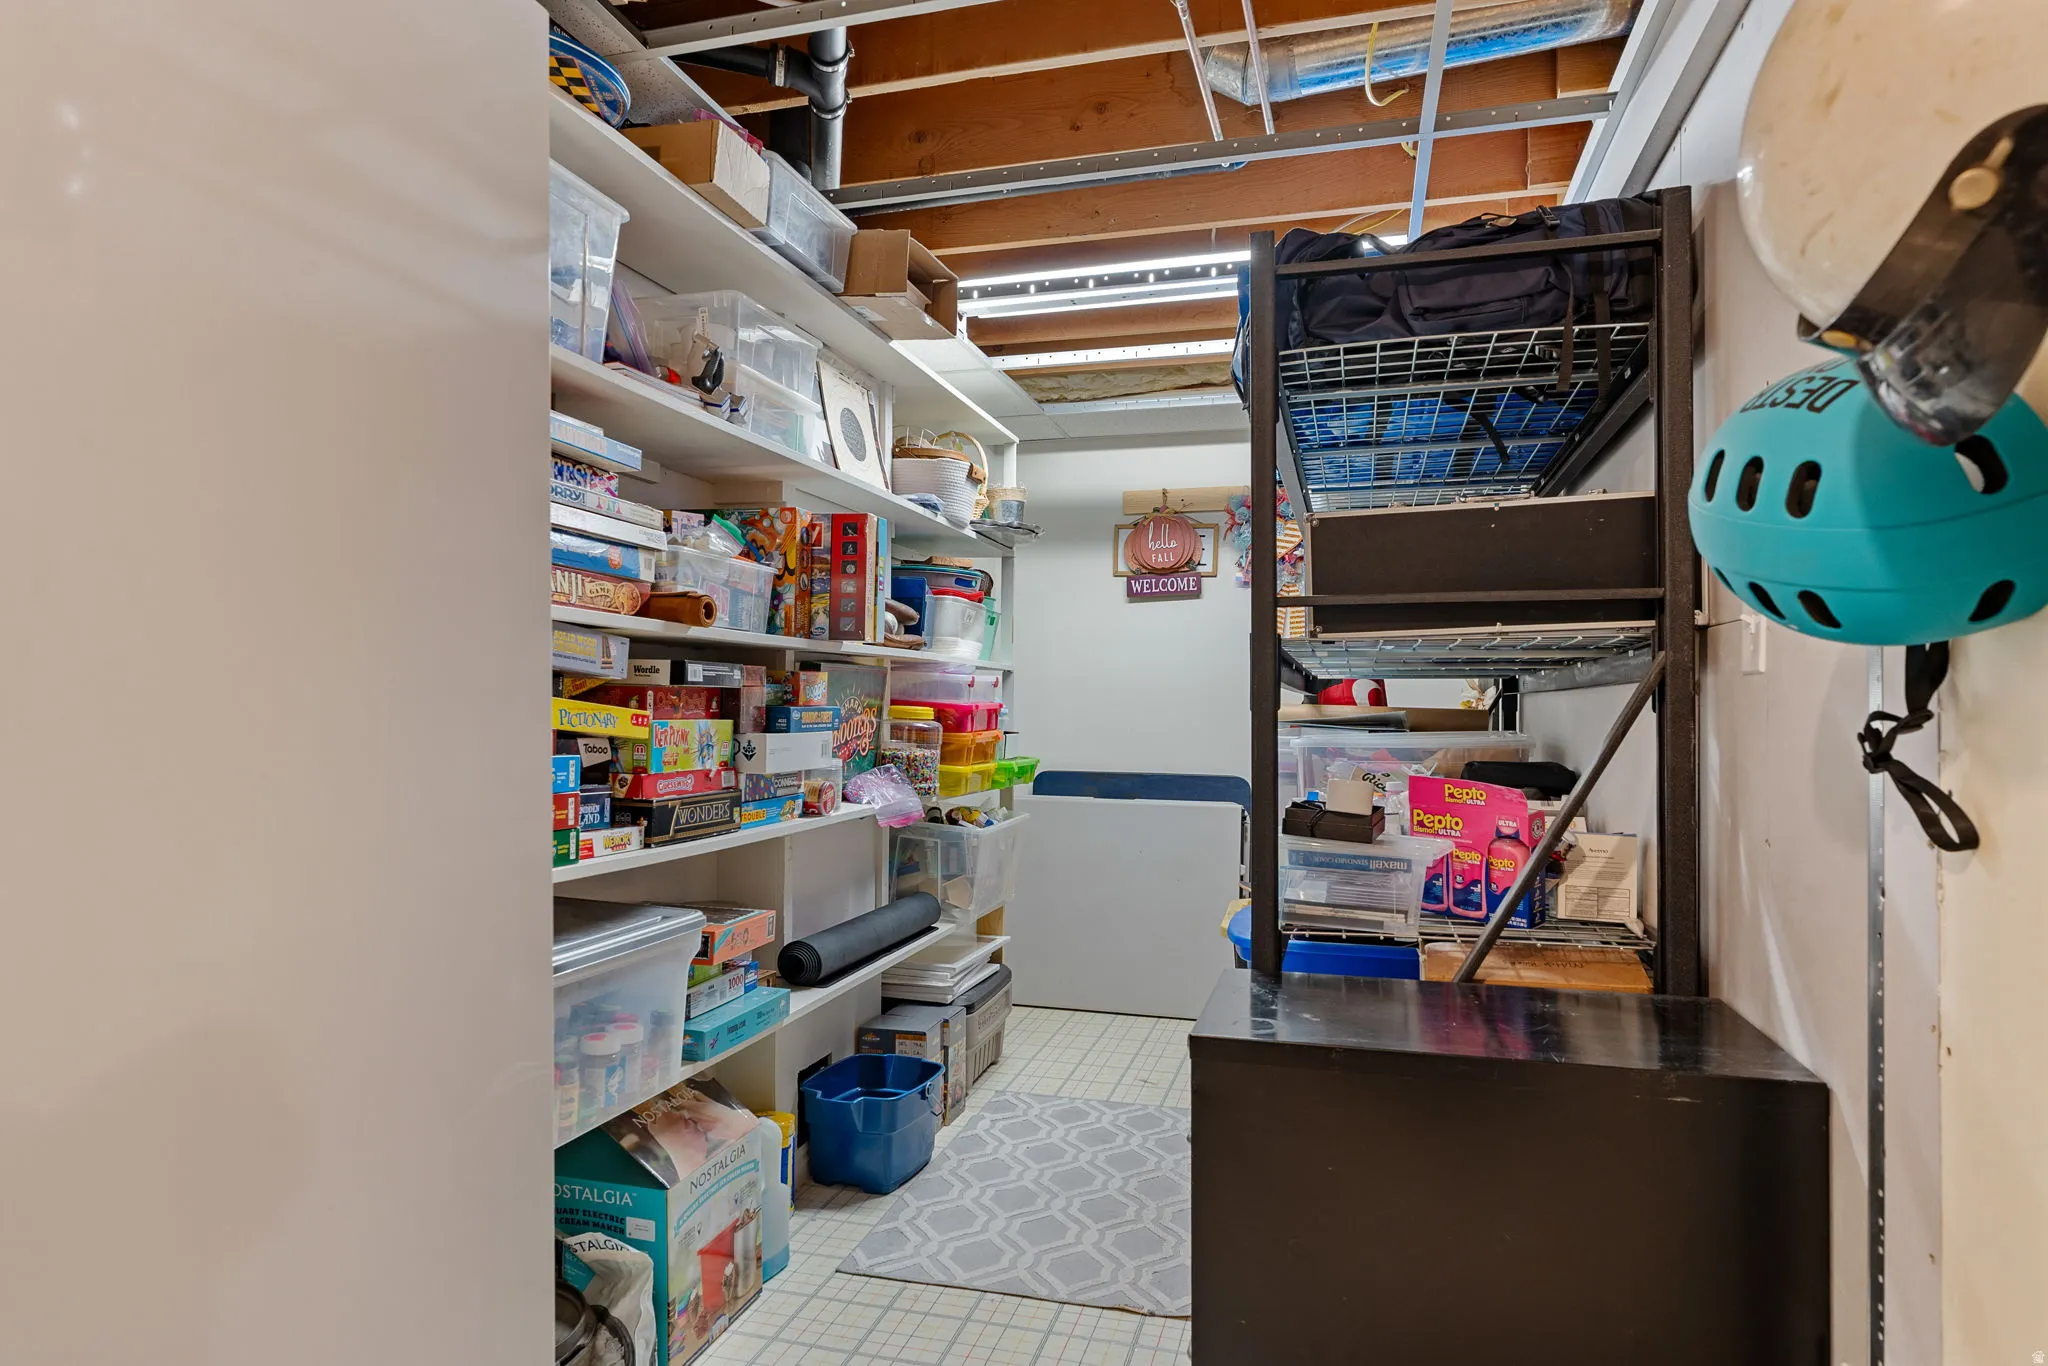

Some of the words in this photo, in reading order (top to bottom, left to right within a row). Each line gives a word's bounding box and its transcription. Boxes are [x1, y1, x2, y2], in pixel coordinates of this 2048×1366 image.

[1149, 522, 1178, 551] hello
[1152, 554, 1175, 563] FALL
[589, 588, 611, 596] GAME
[1131, 577, 1198, 594] WELCOME
[633, 665, 660, 674] Wordle
[559, 708, 618, 728] PICTIONARY
[583, 744, 608, 755] Taboo
[1444, 783, 1487, 804] Pepto
[1466, 798, 1486, 806] ULTRA
[678, 803, 730, 824] WONDERS
[1412, 808, 1464, 831] Pepto
[1497, 819, 1517, 827] ULTRA
[1438, 828, 1462, 837] ULTRA
[1453, 848, 1482, 861] Pepto
[1488, 855, 1516, 869] Pepto
[1369, 859, 1409, 870] maxell
[728, 974, 744, 990] 1000
[632, 1086, 697, 1128] NOSTALGIA
[689, 1144, 746, 1194] NOSTALGIA
[582, 1209, 625, 1225] ELECTRIC
[560, 1217, 590, 1228] CREAM
[592, 1221, 625, 1236] MAKER
